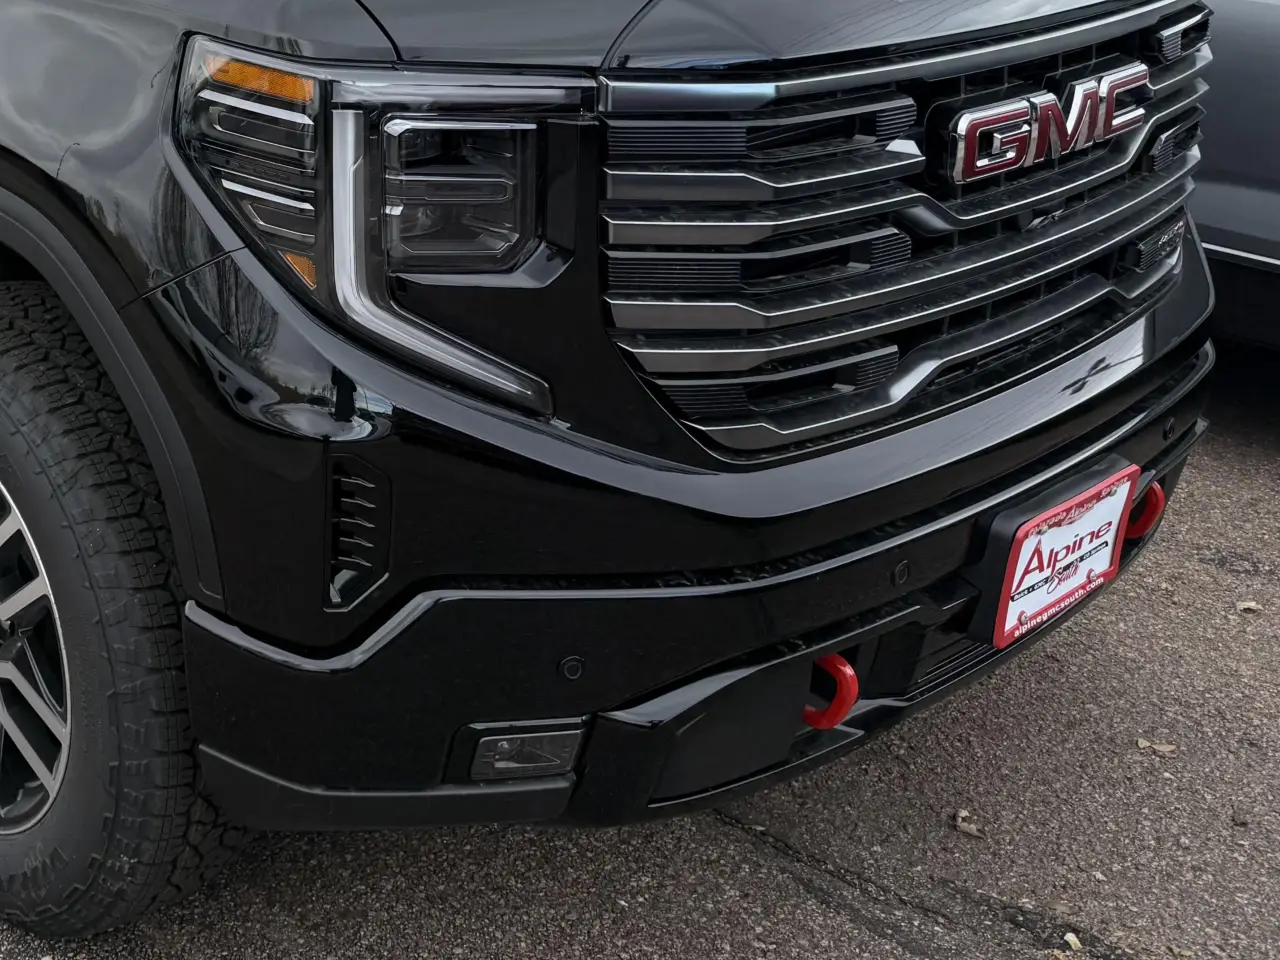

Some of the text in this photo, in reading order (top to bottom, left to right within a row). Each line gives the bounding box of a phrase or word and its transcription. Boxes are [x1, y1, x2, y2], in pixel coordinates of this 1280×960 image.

[953, 62, 1149, 184] GMC
[1011, 520, 1113, 596] Alpine
[1013, 576, 1105, 638] alpinegmcsouth.com
